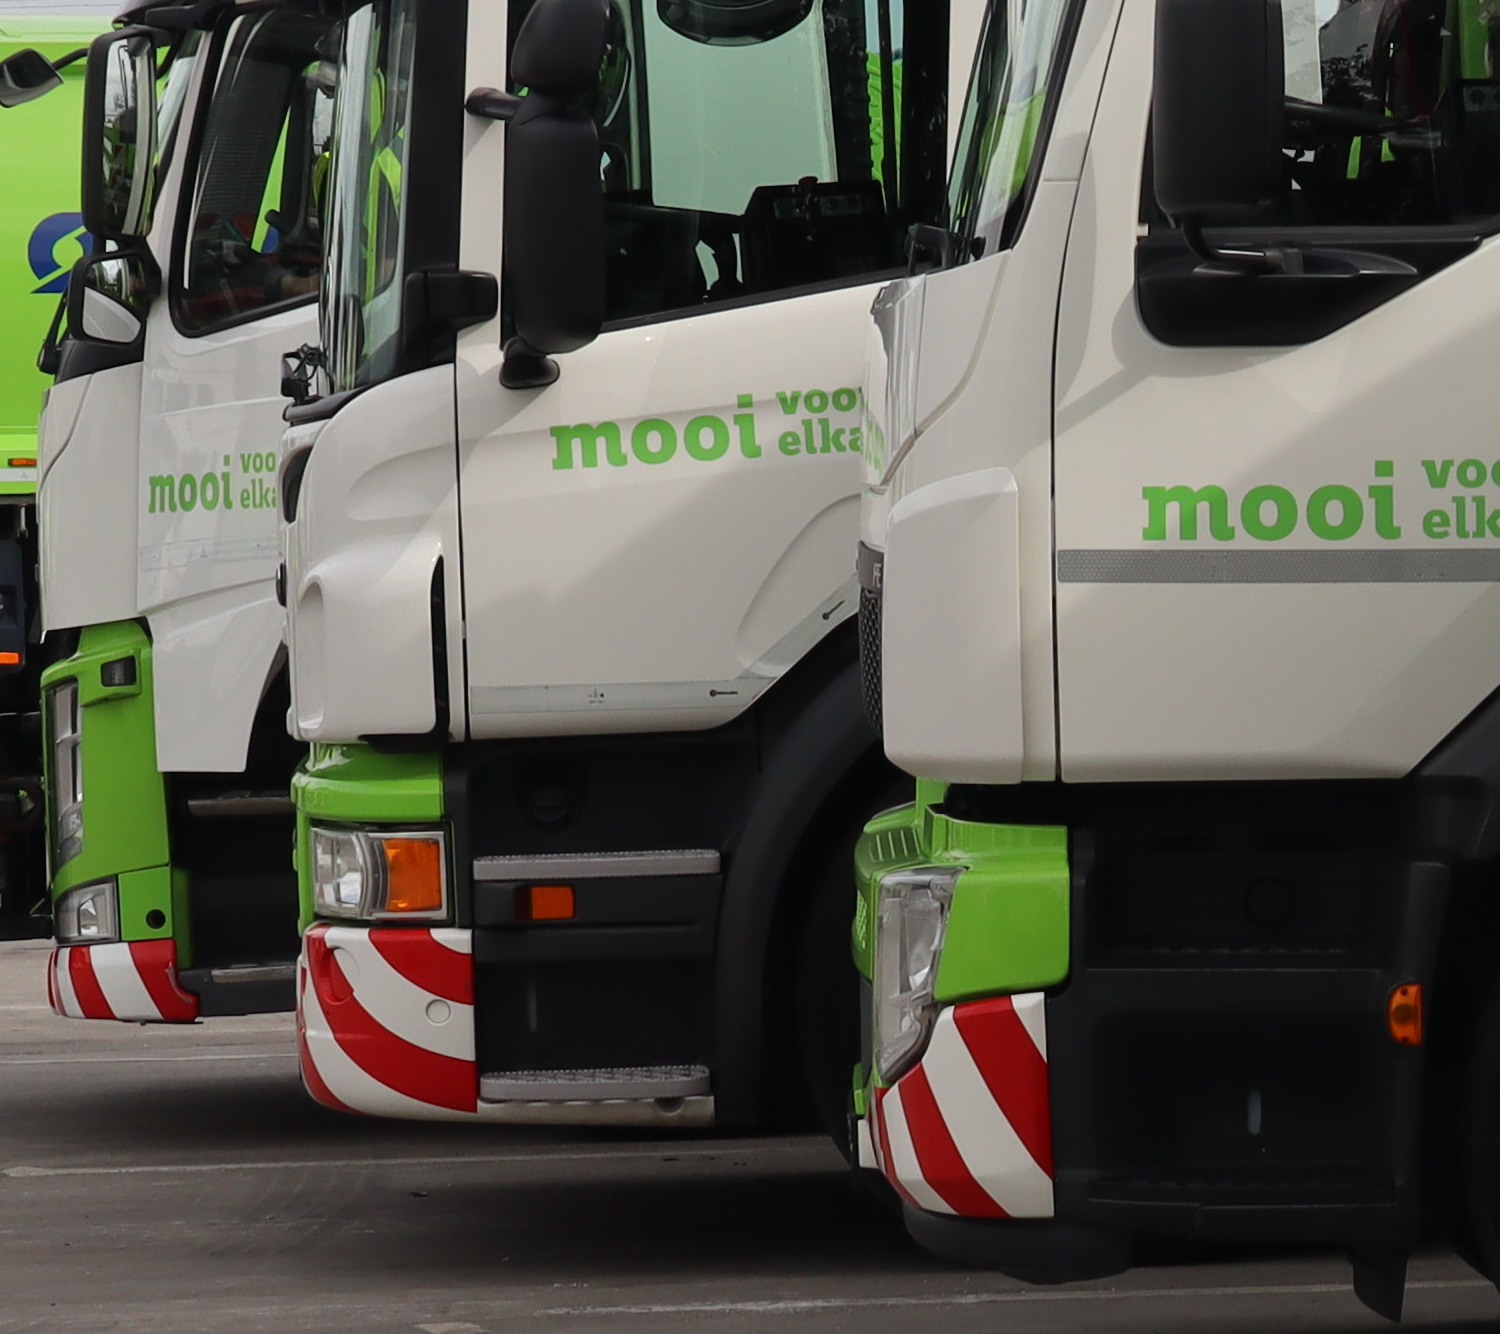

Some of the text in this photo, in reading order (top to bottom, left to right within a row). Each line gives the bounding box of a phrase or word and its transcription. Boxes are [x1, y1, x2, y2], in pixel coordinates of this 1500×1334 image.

[550, 393, 763, 471] mooi
[775, 386, 862, 416] voo
[148, 454, 233, 514] mooi
[1142, 460, 1401, 542] mooi
